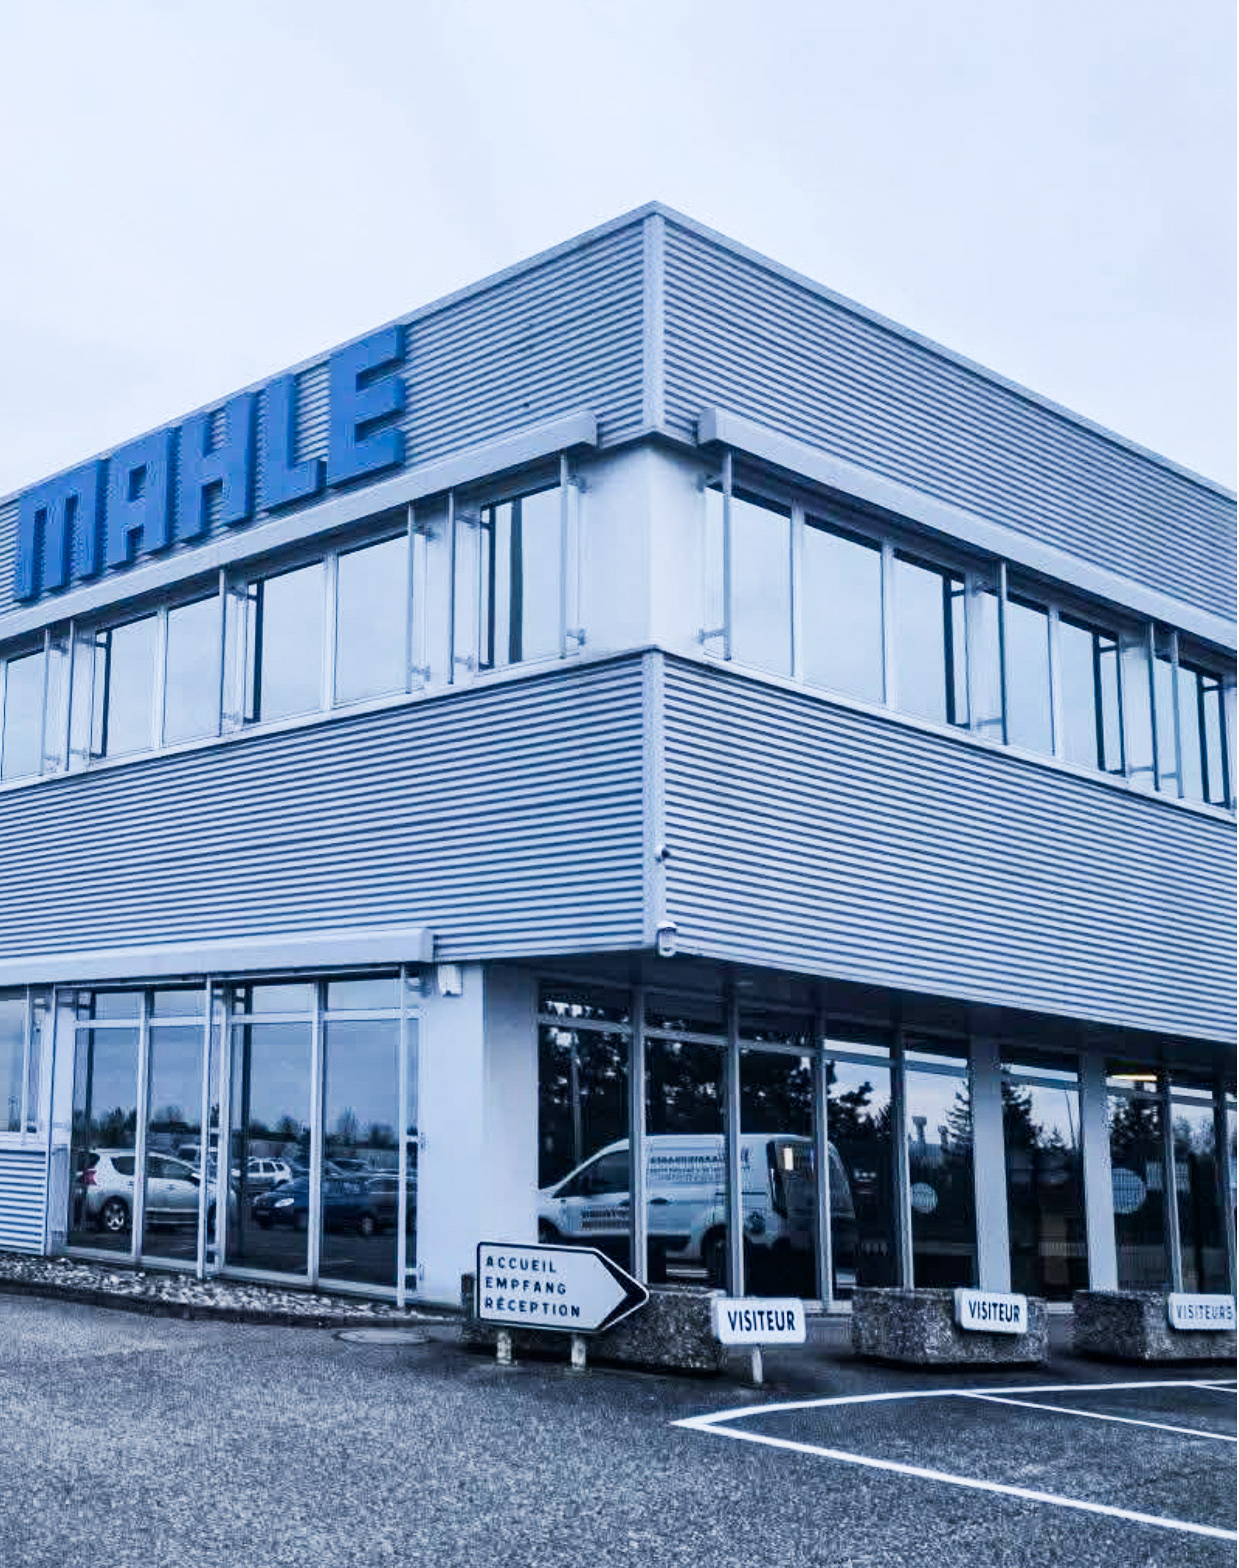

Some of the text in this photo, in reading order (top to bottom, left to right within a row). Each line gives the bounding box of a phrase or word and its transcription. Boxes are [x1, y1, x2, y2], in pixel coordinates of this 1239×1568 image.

[14, 324, 408, 606] MAHLE
[486, 1256, 556, 1273] ACCUEIL
[485, 1277, 566, 1295] EMPFANG
[485, 1296, 580, 1318] RÉCEPTION
[969, 1300, 1020, 1322] VISITEUR
[1177, 1305, 1232, 1319] VISITEURS
[728, 1310, 795, 1331] VISITEUR
